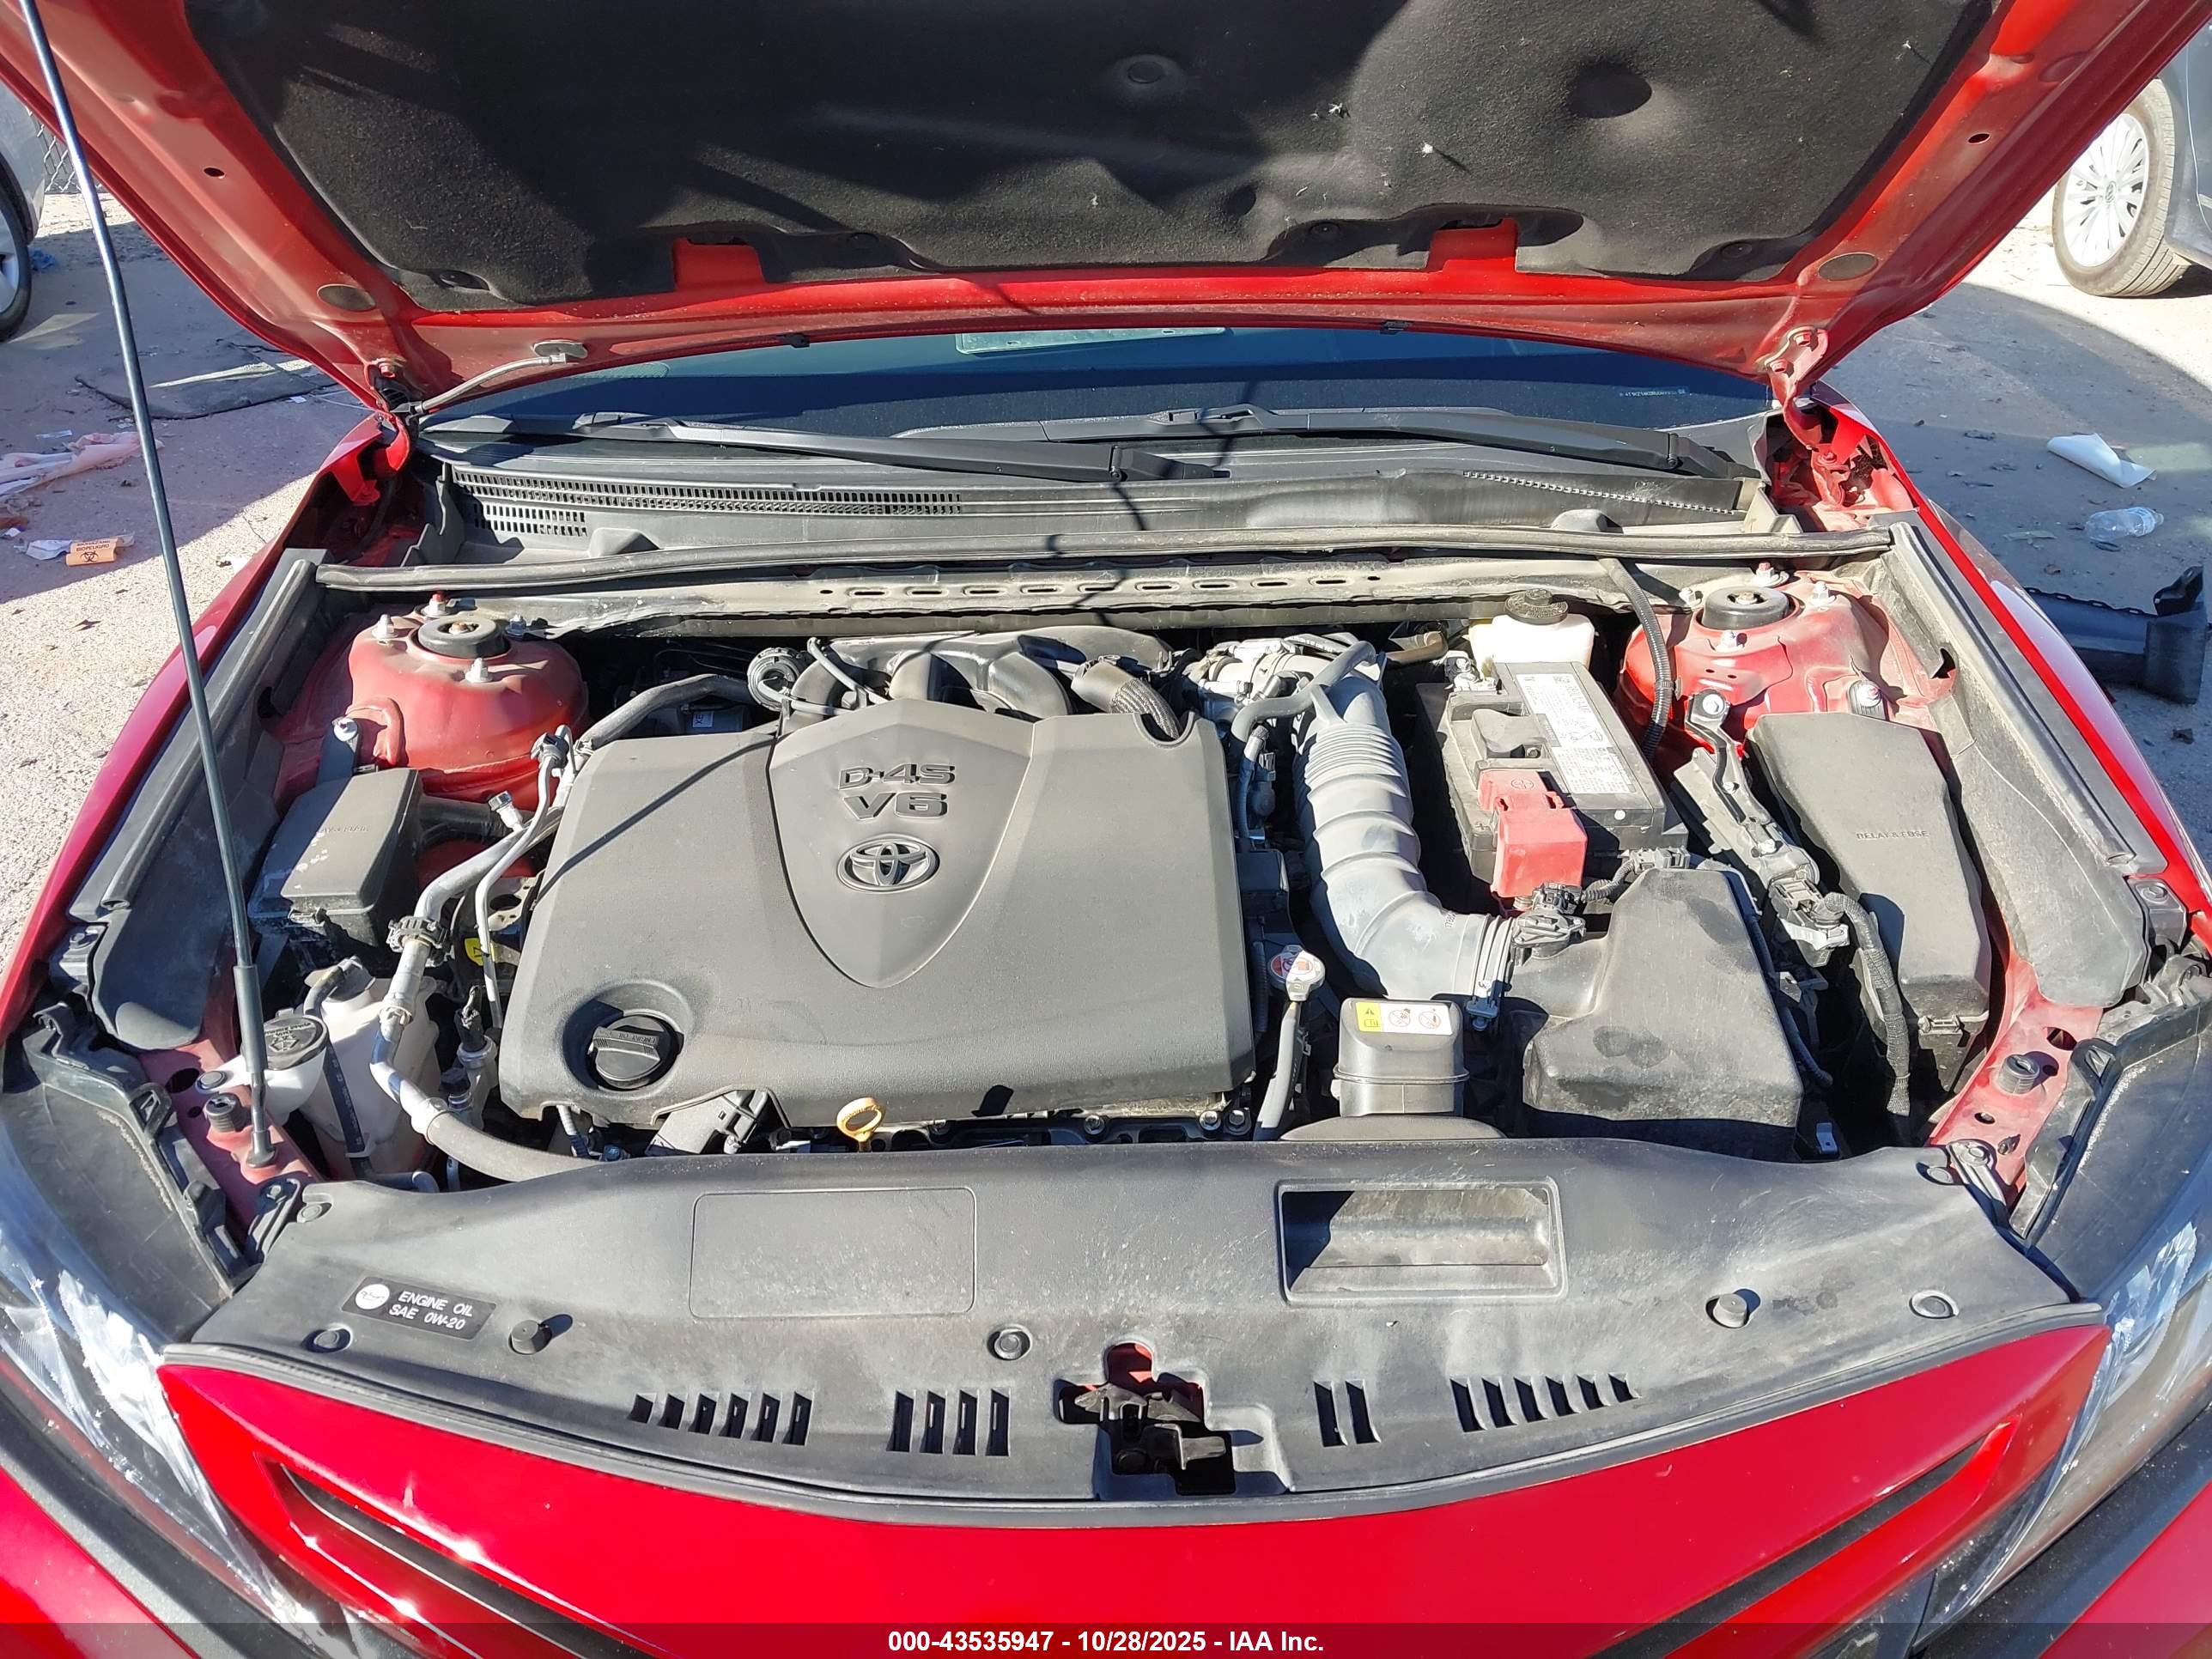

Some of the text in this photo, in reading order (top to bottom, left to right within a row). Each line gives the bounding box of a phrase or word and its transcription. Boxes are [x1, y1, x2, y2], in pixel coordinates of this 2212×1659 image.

[842, 791, 948, 819] V6
[389, 1304, 466, 1330] SAE 0W-20
[398, 1291, 473, 1317] ENGINE OIL
